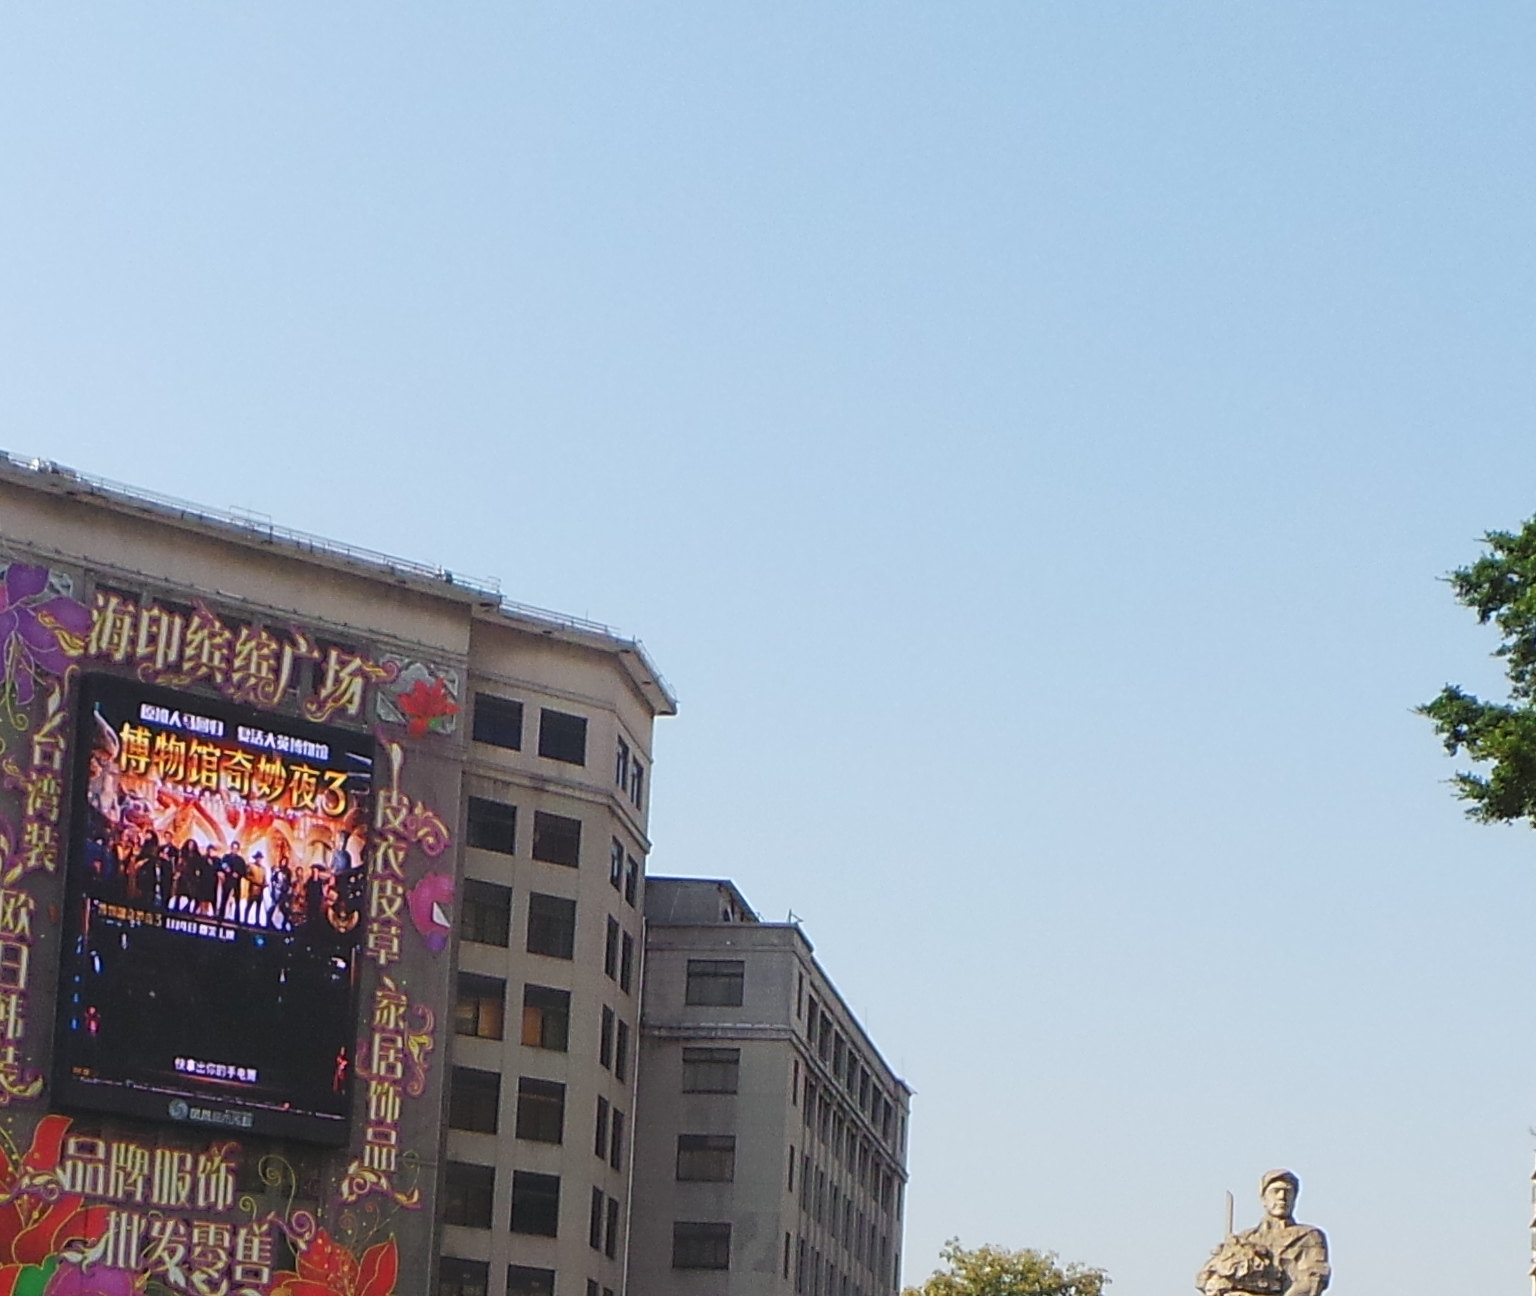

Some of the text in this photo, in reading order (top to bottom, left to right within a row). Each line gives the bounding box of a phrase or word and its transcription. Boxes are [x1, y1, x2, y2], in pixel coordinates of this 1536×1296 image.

[88, 593, 370, 716] 海印缤缤广场
[23, 688, 66, 872] 台湾装
[119, 721, 350, 817] 博物馆奇妙夜3
[366, 772, 407, 966] 皮衣皮草
[364, 978, 408, 1173] 家居饰品
[65, 1136, 238, 1213] 品牌服饰
